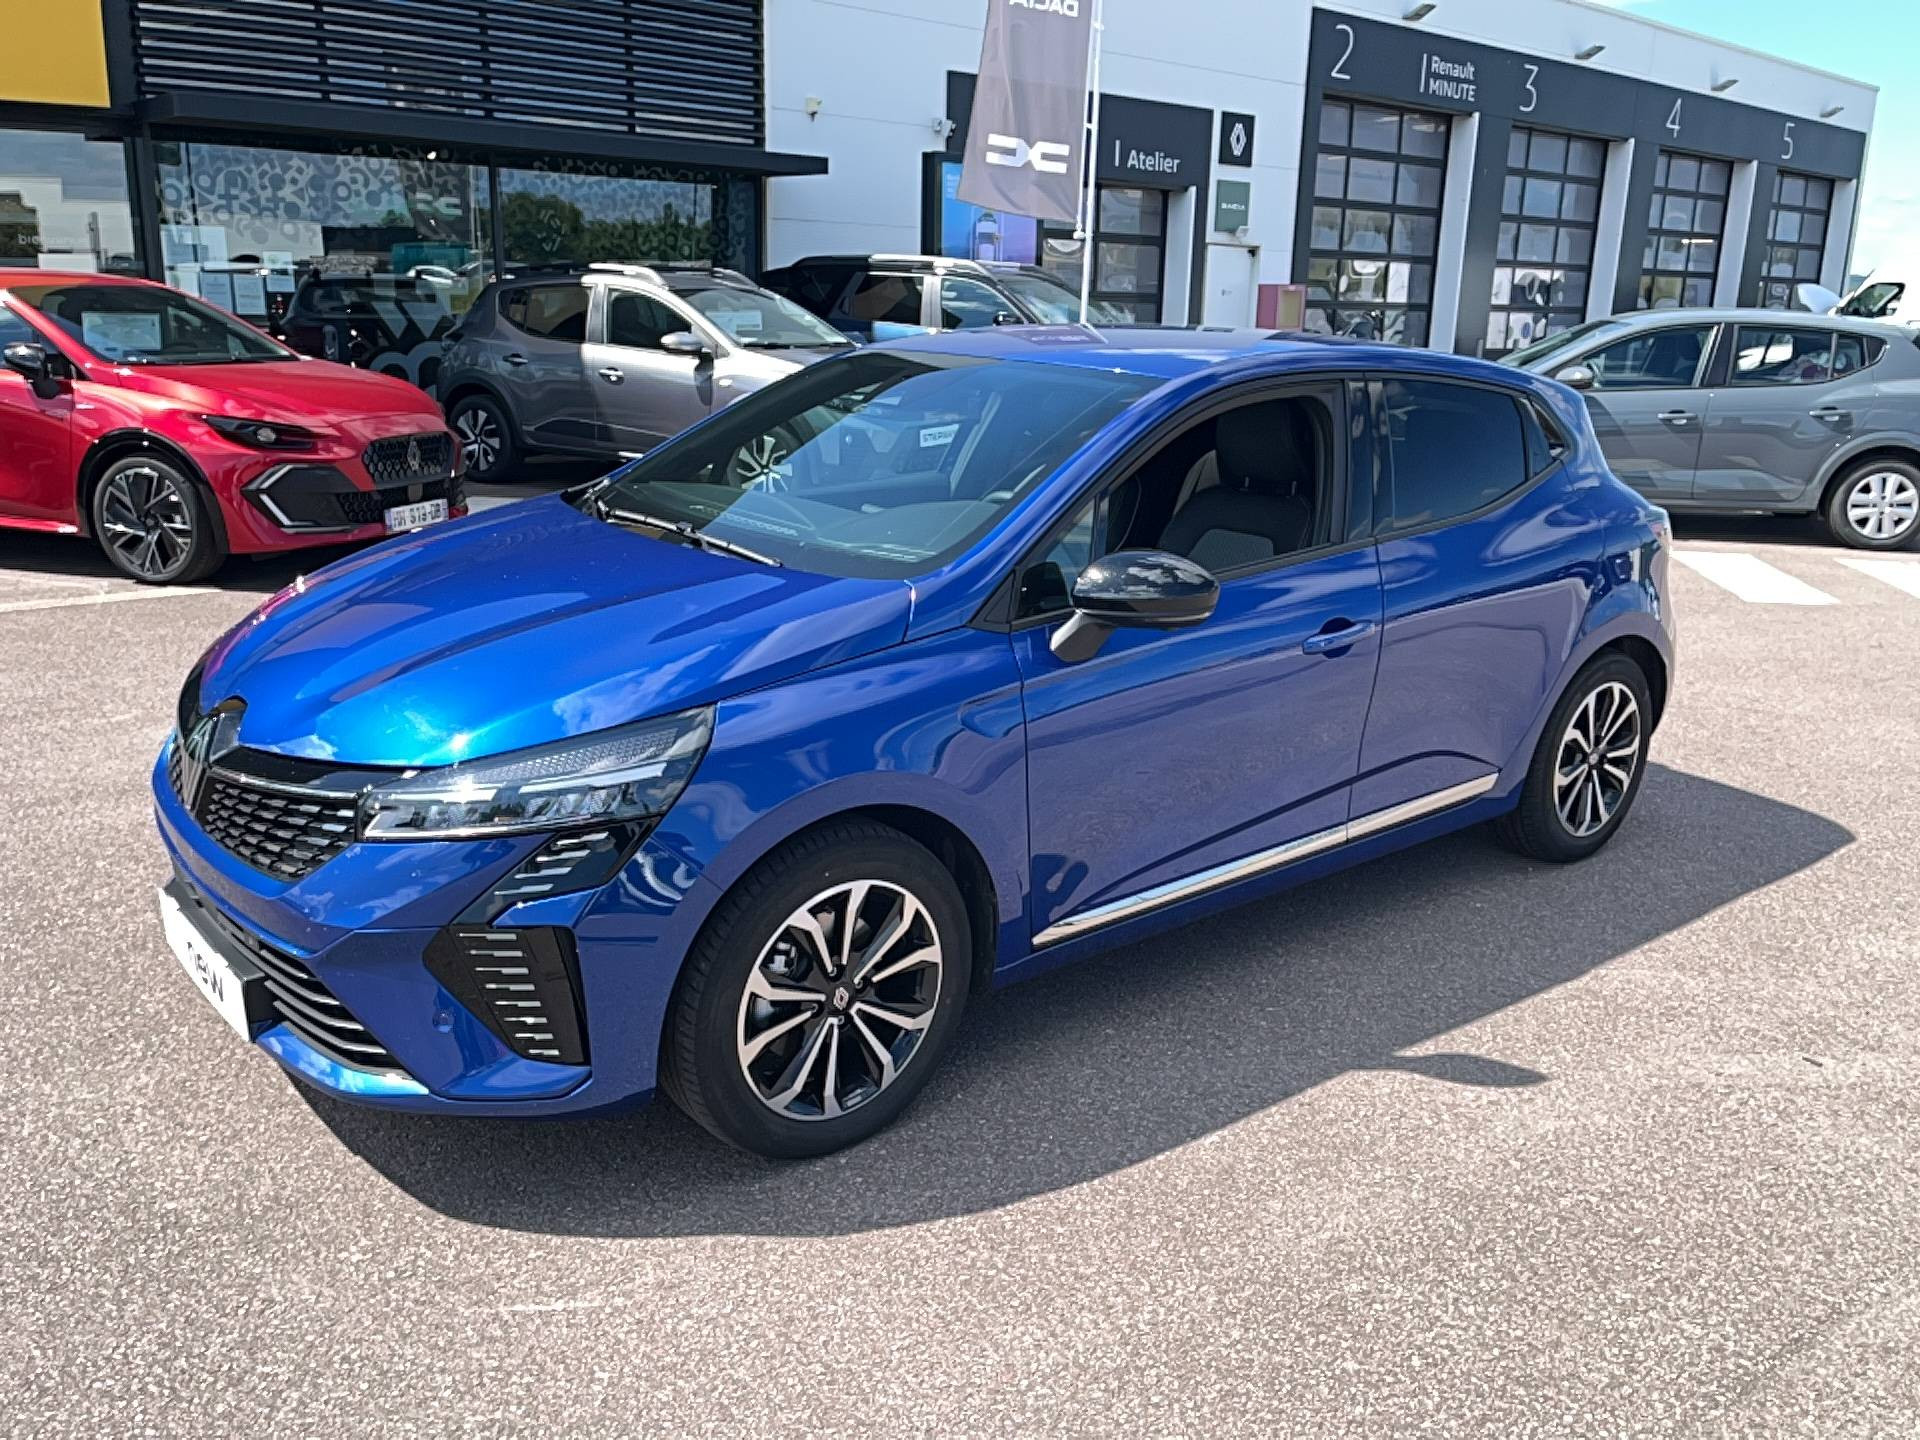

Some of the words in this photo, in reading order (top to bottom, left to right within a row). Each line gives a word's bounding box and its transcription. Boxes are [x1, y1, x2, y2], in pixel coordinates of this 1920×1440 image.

[1330, 23, 1354, 80] 2
[1430, 55, 1476, 81] Renault
[1429, 77, 1477, 102] MINUTE
[1519, 63, 1540, 112] 3
[1665, 98, 1683, 139] 4
[1780, 121, 1796, 160] 5
[1126, 149, 1181, 173] Atelier
